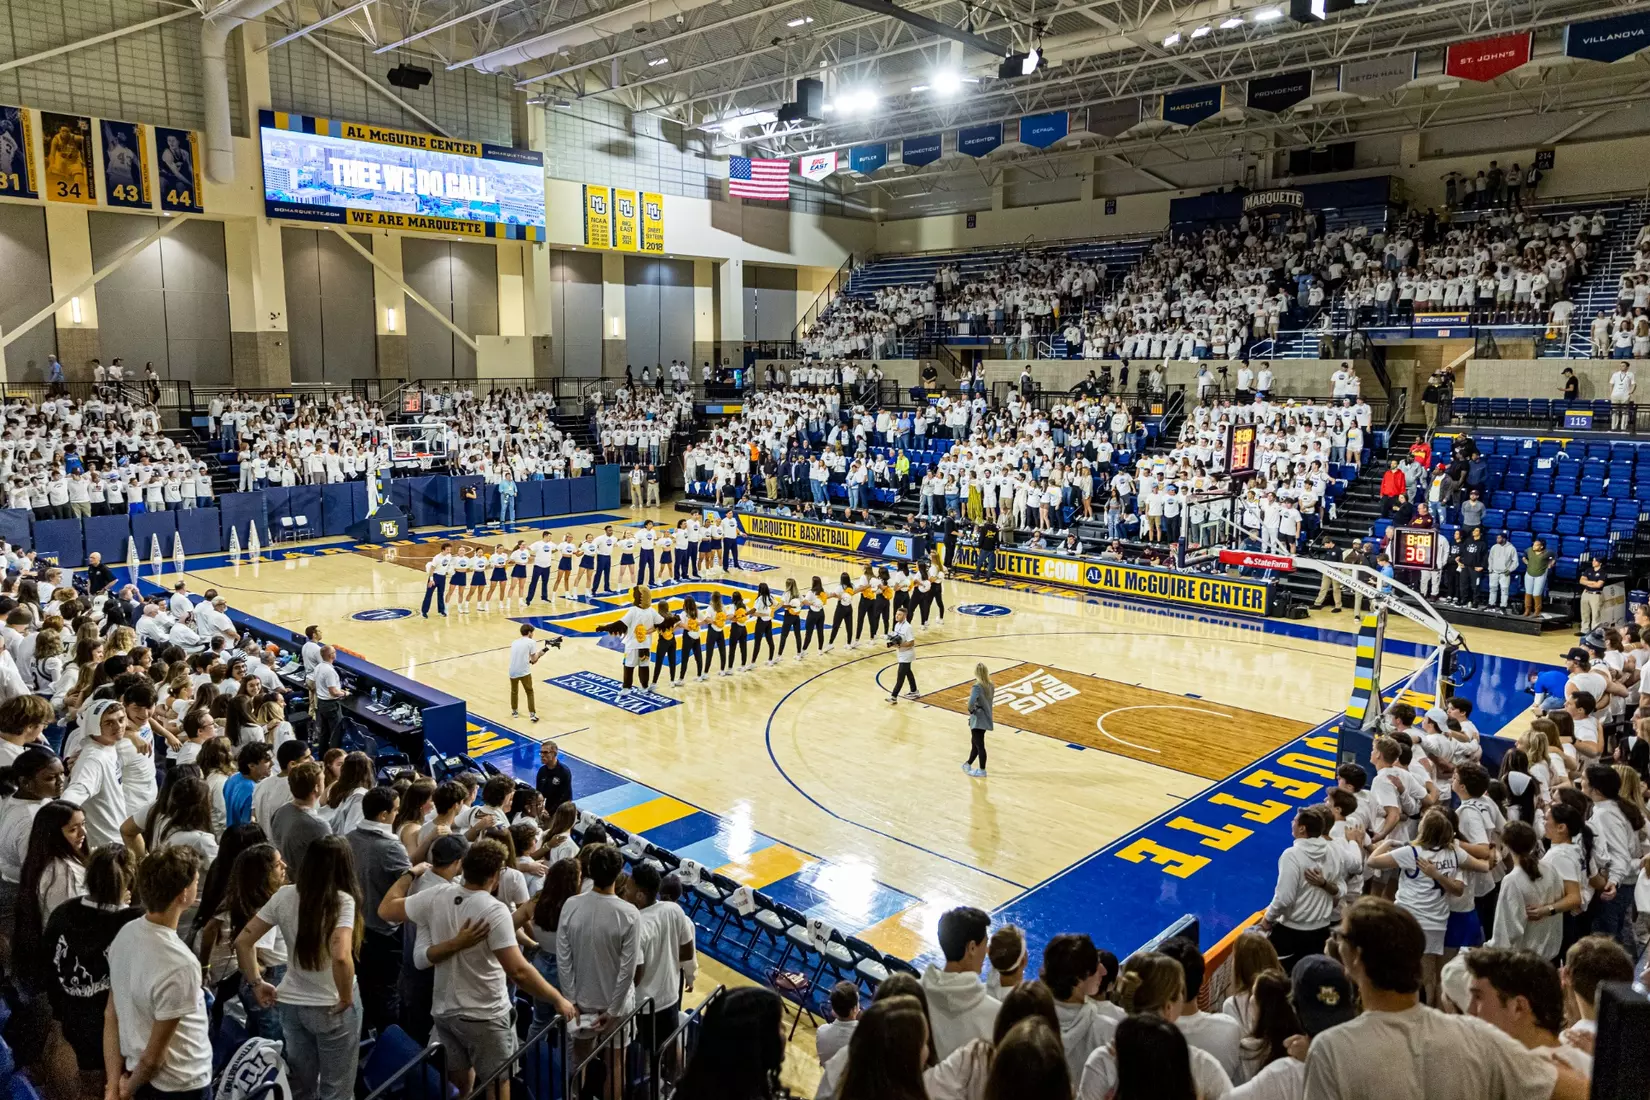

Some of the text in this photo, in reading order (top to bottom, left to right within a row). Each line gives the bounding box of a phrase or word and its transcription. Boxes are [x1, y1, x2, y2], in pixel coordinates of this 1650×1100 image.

[1582, 29, 1645, 44] VILLANOVA
[1460, 50, 1516, 65] ST. JOHN'S
[1350, 68, 1405, 83] SETON HALL
[1254, 85, 1303, 98] PROVIDENCE
[1169, 100, 1213, 112] MARQUETTE
[1032, 127, 1055, 135] DEPAUL
[347, 126, 478, 155] AL McGUIRE CENTER
[964, 136, 996, 146] CREIGHTON
[904, 145, 940, 156] CONNECTICUT
[809, 162, 828, 171] EAST
[329, 157, 496, 204] THEE WE DO CALL
[56, 181, 82, 198] 34
[113, 184, 139, 202] 43
[166, 189, 192, 207] 44
[590, 195, 606, 215] MU
[619, 199, 634, 218] MU
[1244, 191, 1303, 210] MARQUETTE
[646, 203, 661, 221] MU
[351, 211, 482, 234] WE ARE MARQUETTE
[646, 242, 663, 251] 2018
[1570, 416, 1587, 426] 115
[1232, 444, 1249, 470] 30
[380, 520, 399, 539] MU
[751, 517, 850, 548] MARQUETTE BASKETBALL
[895, 538, 908, 556] MU
[1406, 534, 1432, 547] 8:08
[1406, 547, 1426, 562] 30
[1087, 568, 1263, 610] AL AL McGUIRE CENTER
